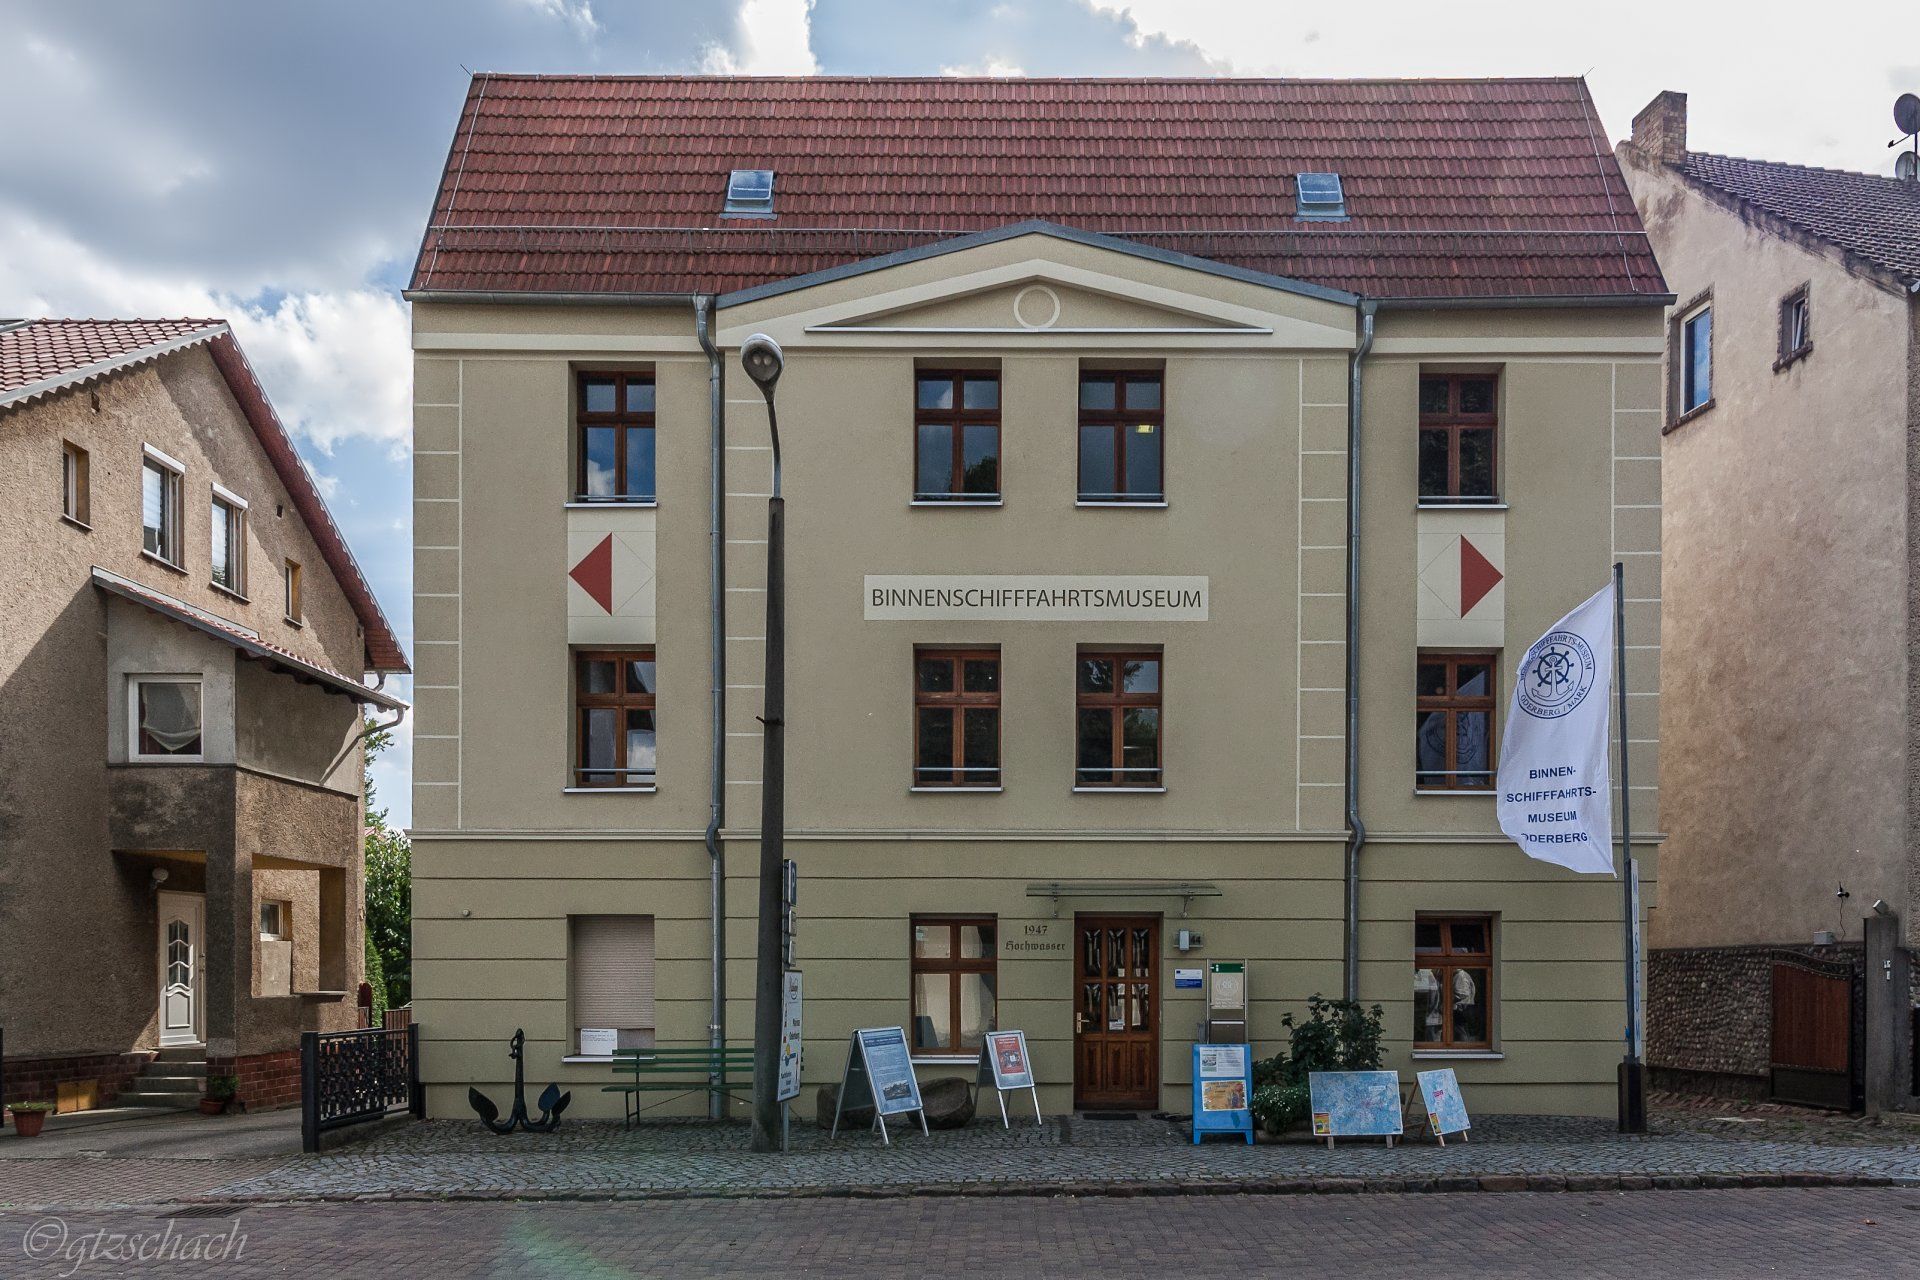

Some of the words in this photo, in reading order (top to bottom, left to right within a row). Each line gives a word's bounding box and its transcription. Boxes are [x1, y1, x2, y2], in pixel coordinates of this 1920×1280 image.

[872, 588, 1202, 608] BINNENSCHIFFFAHRTSMUSEUM
[1520, 694, 1561, 716] ODERBERG
[1568, 685, 1588, 711] MARK
[1529, 766, 1576, 779] BINNEN-
[1506, 786, 1597, 802] SCHIFFFAHRTS-
[1527, 811, 1577, 823] MUSEUM
[1024, 925, 1048, 934] 1947
[1005, 941, 1066, 951] Hochwasser
